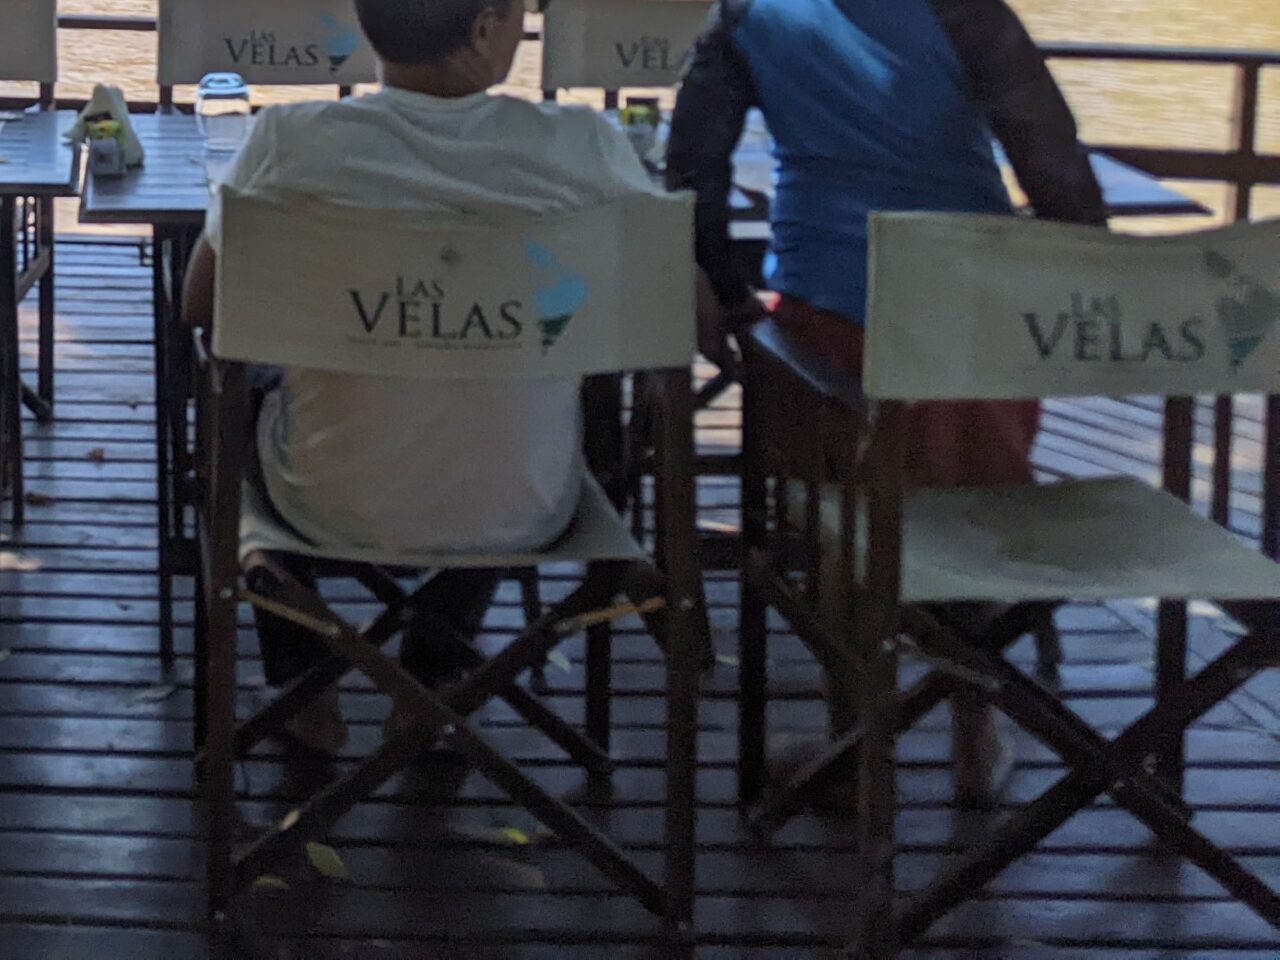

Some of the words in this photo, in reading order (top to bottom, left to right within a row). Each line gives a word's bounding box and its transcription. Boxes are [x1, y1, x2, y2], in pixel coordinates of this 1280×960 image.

[223, 38, 318, 66] VELAS
[395, 275, 445, 299] LAS
[347, 288, 524, 340] VELAS
[1019, 311, 1206, 362] VELAS
